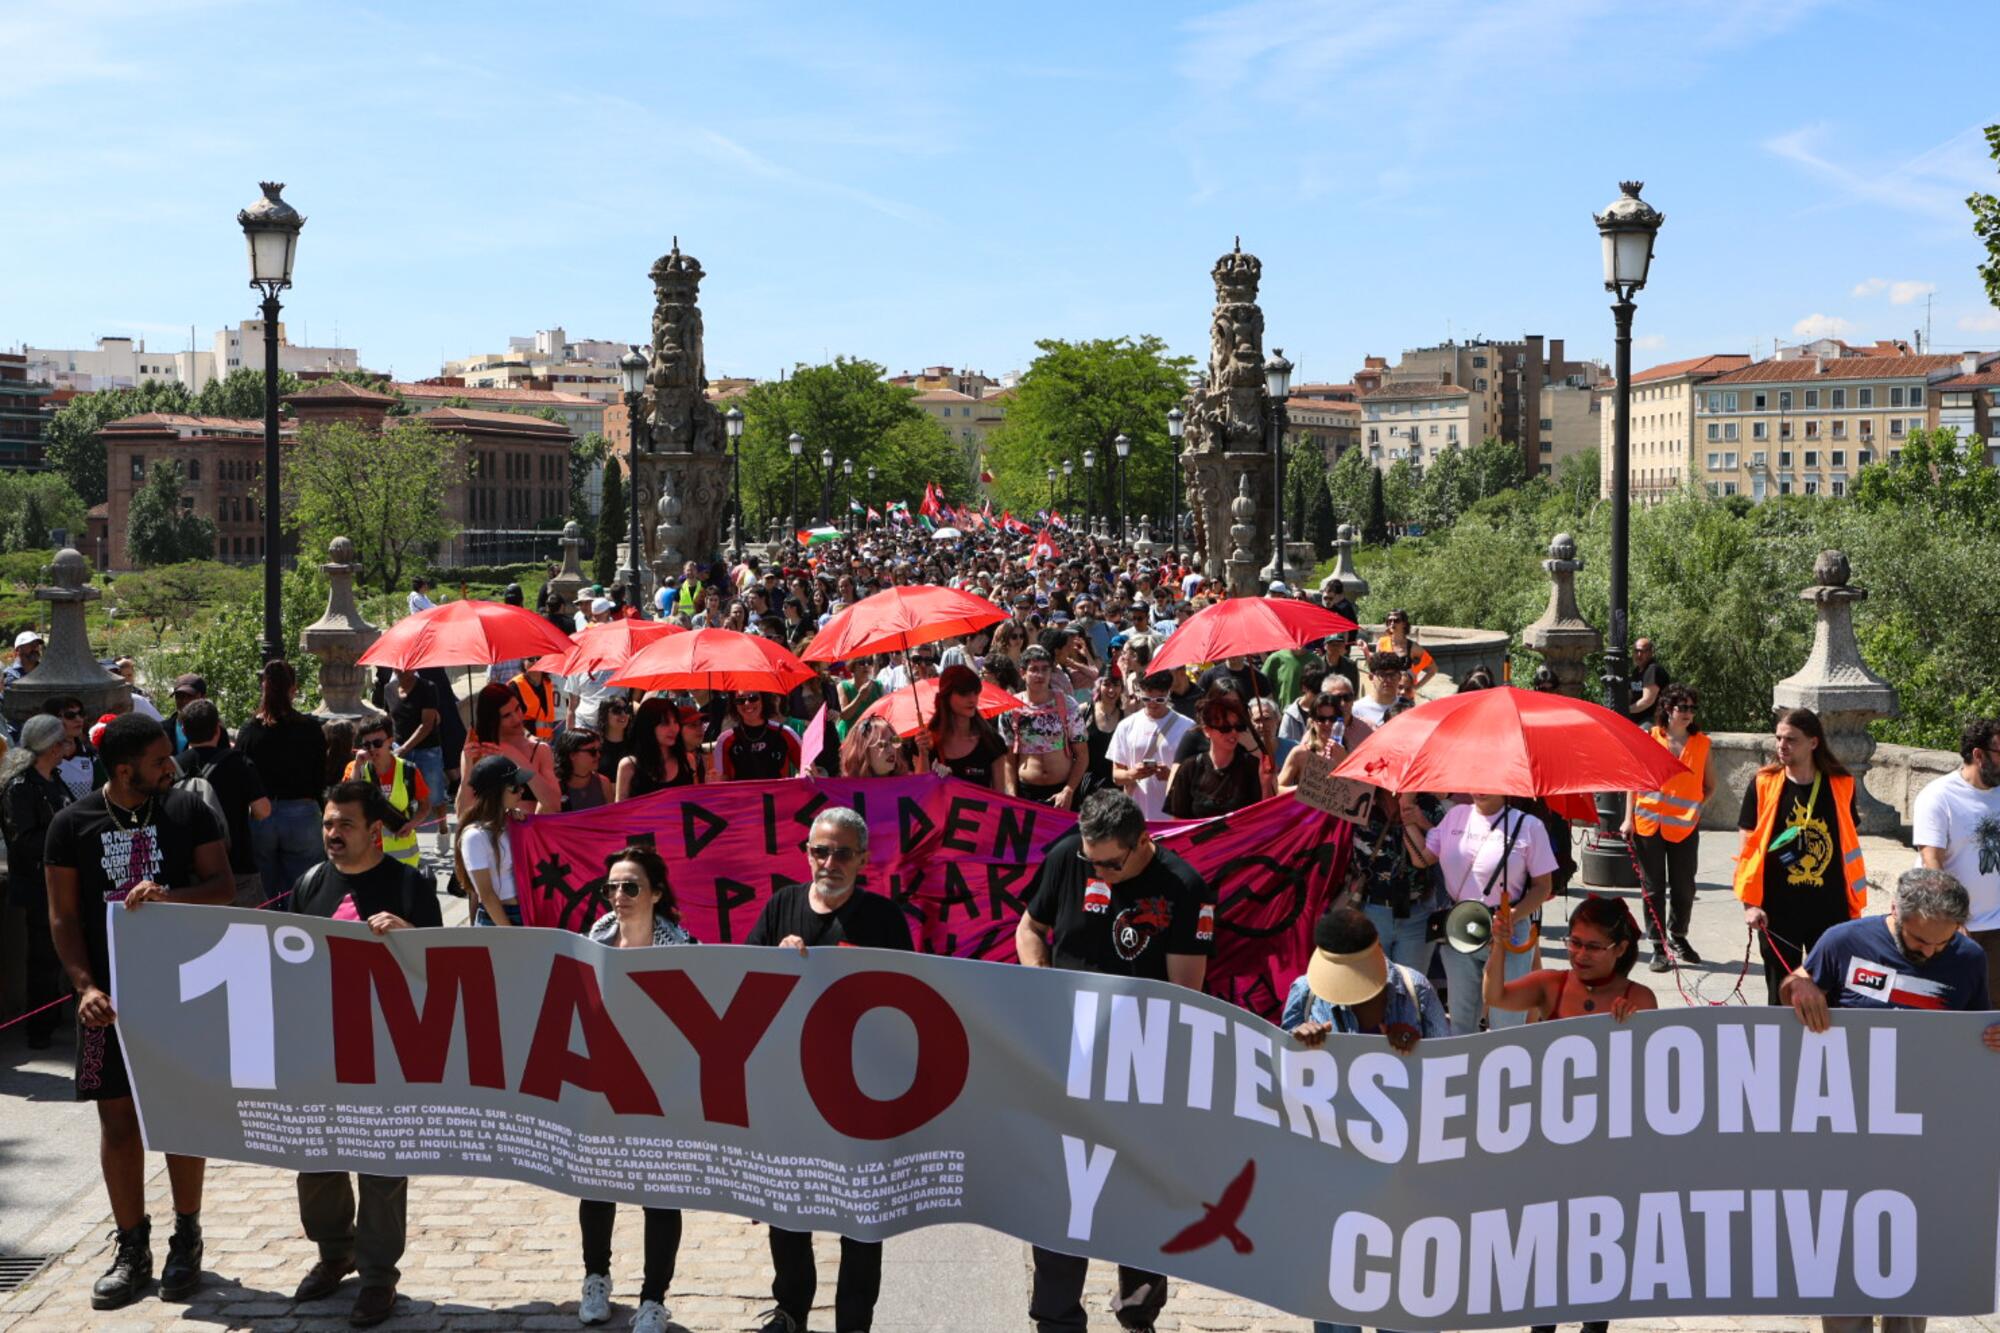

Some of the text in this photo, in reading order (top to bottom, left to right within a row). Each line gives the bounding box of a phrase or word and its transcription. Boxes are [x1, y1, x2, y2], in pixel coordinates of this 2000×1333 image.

[1084, 902, 1108, 914] CGT
[1196, 931, 1213, 940] CGT
[1858, 972, 1882, 986] CNT
[325, 935, 970, 1141] MAYO
[1066, 990, 1924, 1165] INTERSECCIONAL
[237, 1100, 292, 1113] AFEMTRAS
[303, 1104, 326, 1113] CGT
[336, 1105, 383, 1114] MCLMEX
[394, 1105, 416, 1114] CNT
[421, 1105, 482, 1117] COMARCAL
[485, 1109, 506, 1120] SUR
[516, 1113, 535, 1123] CNT
[538, 1118, 572, 1137] MADRID
[579, 1133, 615, 1145] COBAS
[625, 1136, 673, 1148] ESPACIO
[721, 1145, 742, 1156] 15M
[751, 1151, 764, 1162] LA
[767, 1153, 847, 1173] LABORATORIA
[858, 1163, 884, 1174] LIZA
[893, 1150, 965, 1167] MOVIMIENTO
[239, 1110, 964, 1187] MARIKA MADRID OBSERVATORIO DE DDHH EN SALUD MENTAL ORGULLO LOCO PRENDE PLATAFORMA SINDICAL DE LA EMT RED DE
[242, 1120, 301, 1135] SINDICATOS
[306, 1126, 322, 1135] DE
[374, 1128, 413, 1137] GRUPO
[418, 1128, 456, 1137] ADELA
[459, 1130, 474, 1139] DE
[478, 1130, 492, 1140] LA
[495, 1132, 548, 1150] ASAMBLEA
[550, 1145, 593, 1165] POPULAR
[596, 1158, 611, 1167] DE
[707, 1166, 728, 1176] RAL
[731, 1168, 739, 1177] Y
[742, 1170, 800, 1190] SINDICATO
[804, 1182, 828, 1192] SAN
[831, 1178, 928, 1198] BLAS-CANILLEJAS
[939, 1174, 964, 1184] RED
[244, 1130, 324, 1146] INTERLAVAPIES
[337, 1137, 396, 1149] SINDICATO
[400, 1140, 416, 1148] DE
[420, 1140, 485, 1150] INQUILINAS
[497, 1144, 550, 1161] SINDICATO
[552, 1157, 564, 1168] DE
[566, 1162, 624, 1179] MANTEROS
[628, 1171, 643, 1180] DE
[648, 1172, 692, 1183] MADRID
[704, 1176, 761, 1194] SINDICATO
[764, 1188, 801, 1202] OTRAS
[891, 1186, 964, 1206] SOLIDARIDAD
[245, 1140, 286, 1154] OBRERA
[305, 1148, 328, 1157] SOS
[337, 1148, 386, 1160] RACISMO
[395, 1152, 440, 1160] MADRID
[462, 1153, 492, 1162] STEM
[512, 1157, 556, 1176] TABADOL
[571, 1174, 635, 1191] TERRITORIO
[732, 1191, 766, 1207] TRANS
[773, 1203, 788, 1213] EN
[797, 1206, 837, 1216] LUCHA
[856, 1206, 908, 1224] VALIENTE
[916, 1198, 962, 1212] BANGLA
[1061, 1134, 1117, 1241] Y
[1328, 1188, 1918, 1319] COMBATIVO
